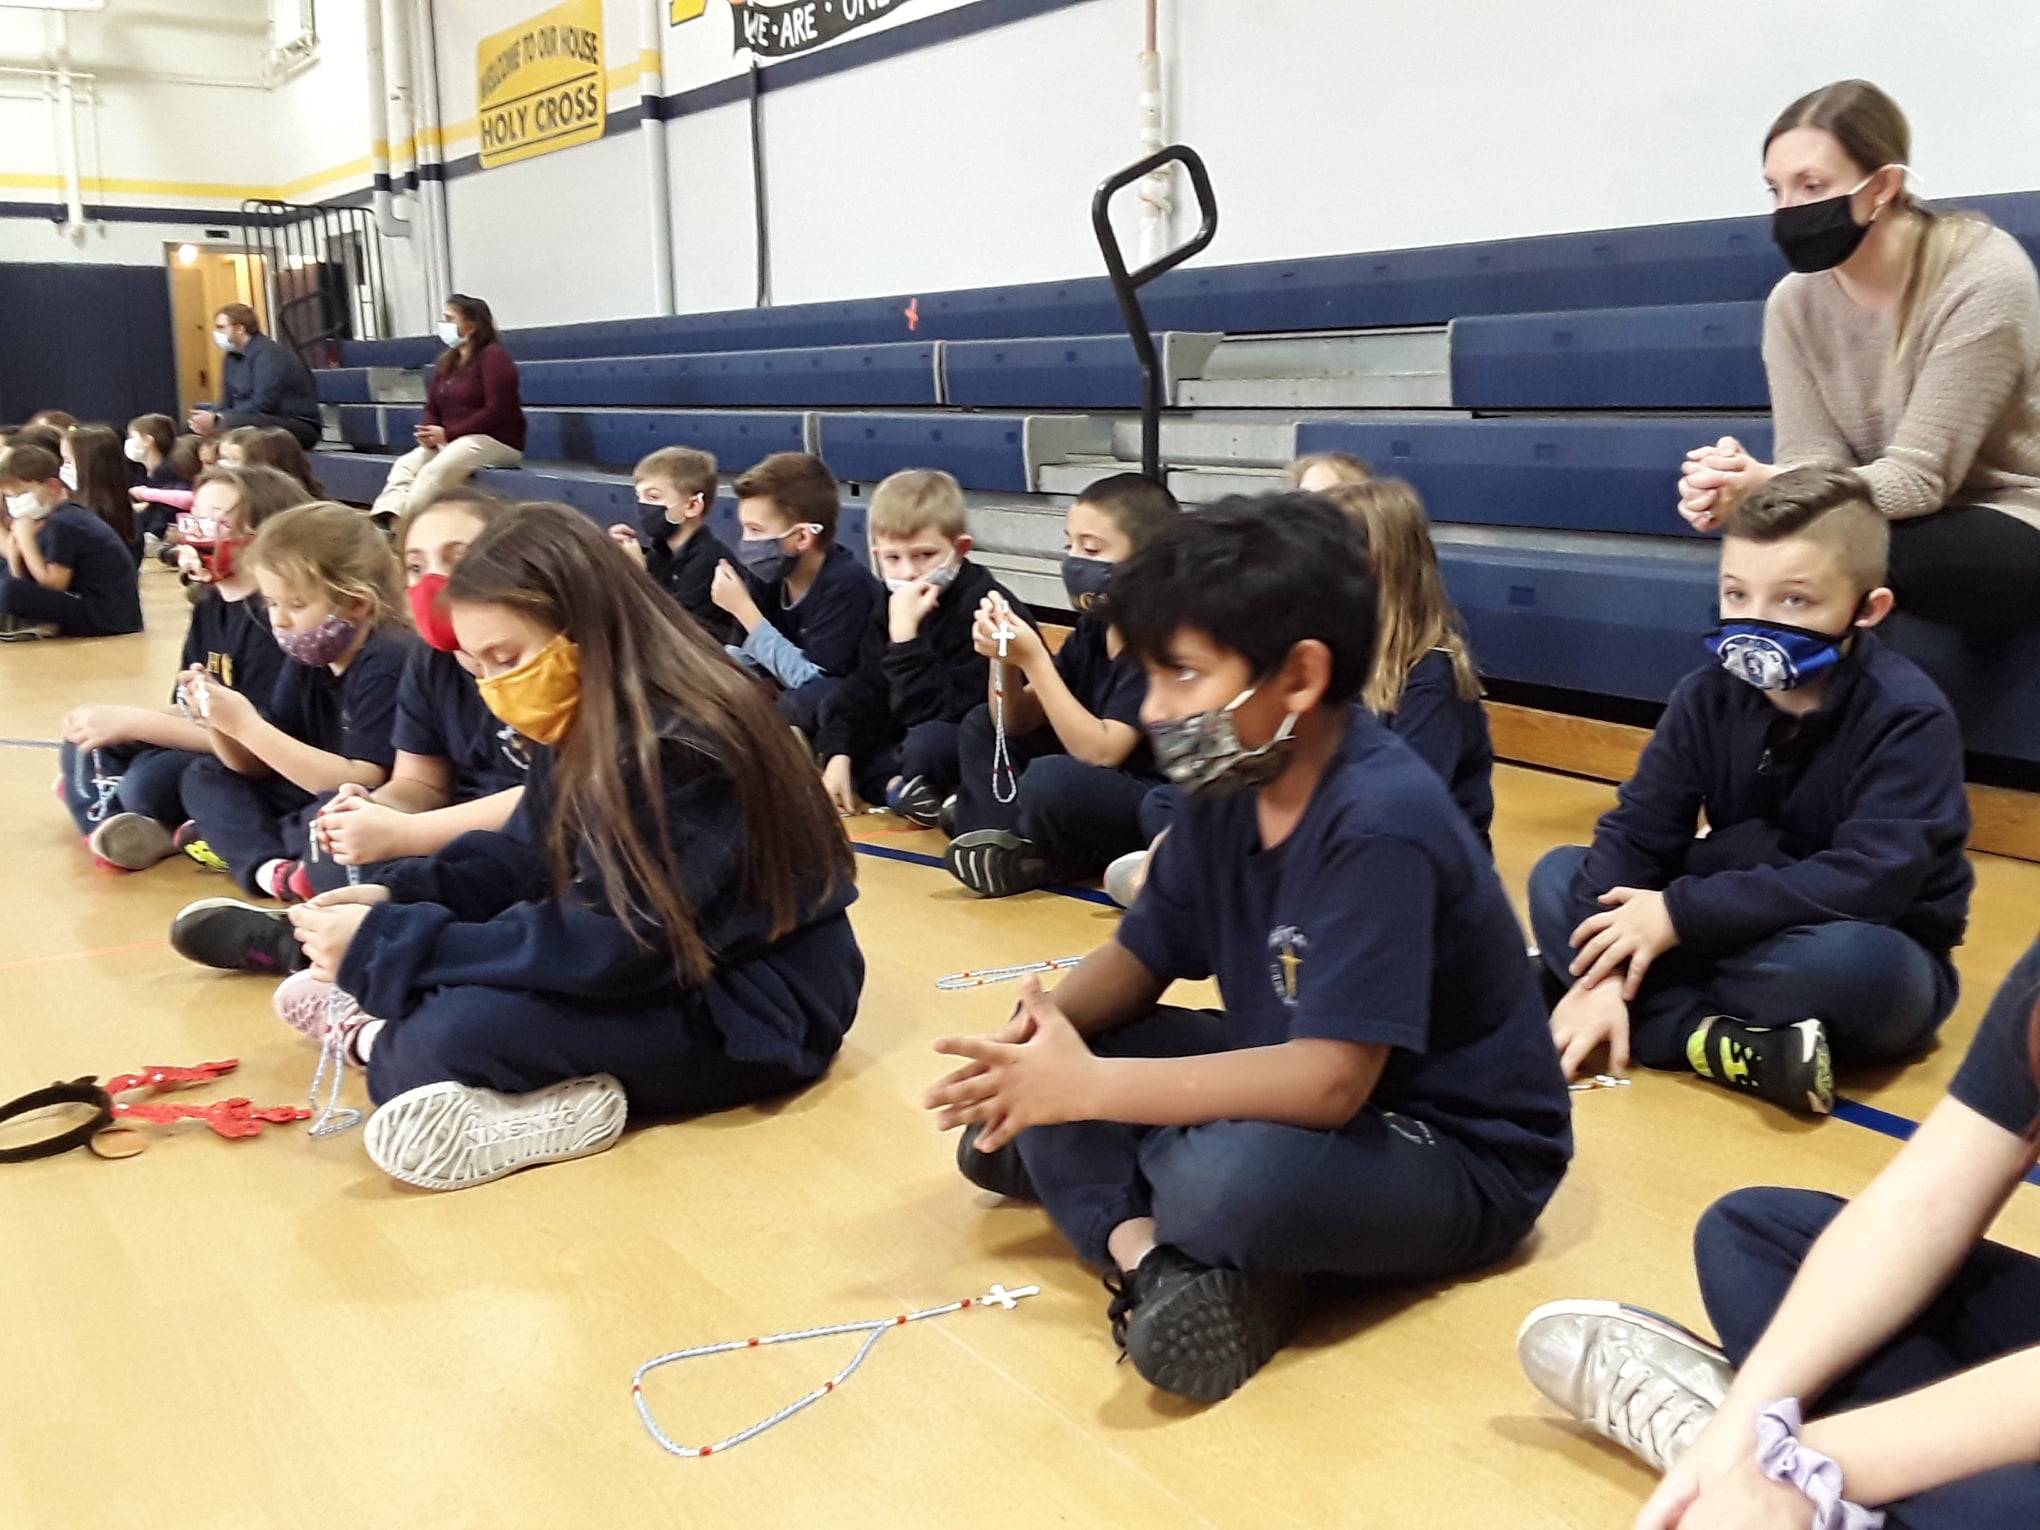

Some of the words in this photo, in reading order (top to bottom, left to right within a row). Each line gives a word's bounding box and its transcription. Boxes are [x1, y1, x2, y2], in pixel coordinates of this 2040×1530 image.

[780, 3, 818, 48] ARE
[481, 104, 528, 149] HOLY
[535, 82, 598, 132] CROSS
